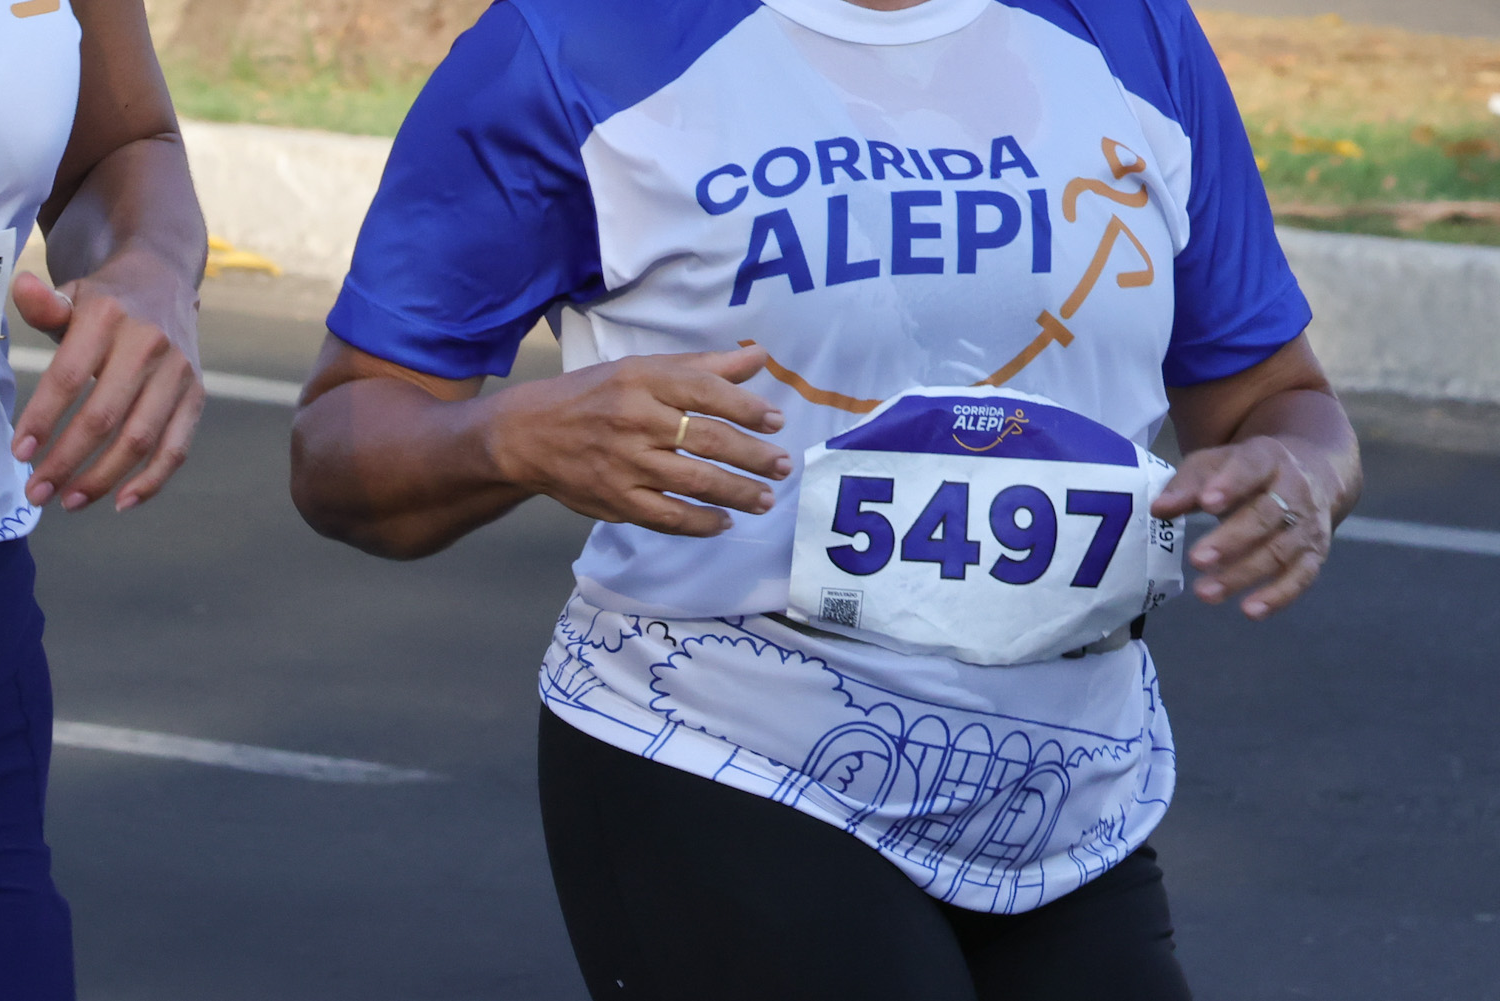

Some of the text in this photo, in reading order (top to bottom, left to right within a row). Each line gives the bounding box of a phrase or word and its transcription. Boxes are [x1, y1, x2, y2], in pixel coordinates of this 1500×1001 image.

[695, 135, 1039, 216] CORRIDA
[728, 188, 1052, 307] ALEPI
[952, 415, 1004, 432] ALEPI
[953, 404, 1004, 418] CORRIDA
[825, 475, 1133, 588] 5497
[1159, 517, 1174, 553] 497
